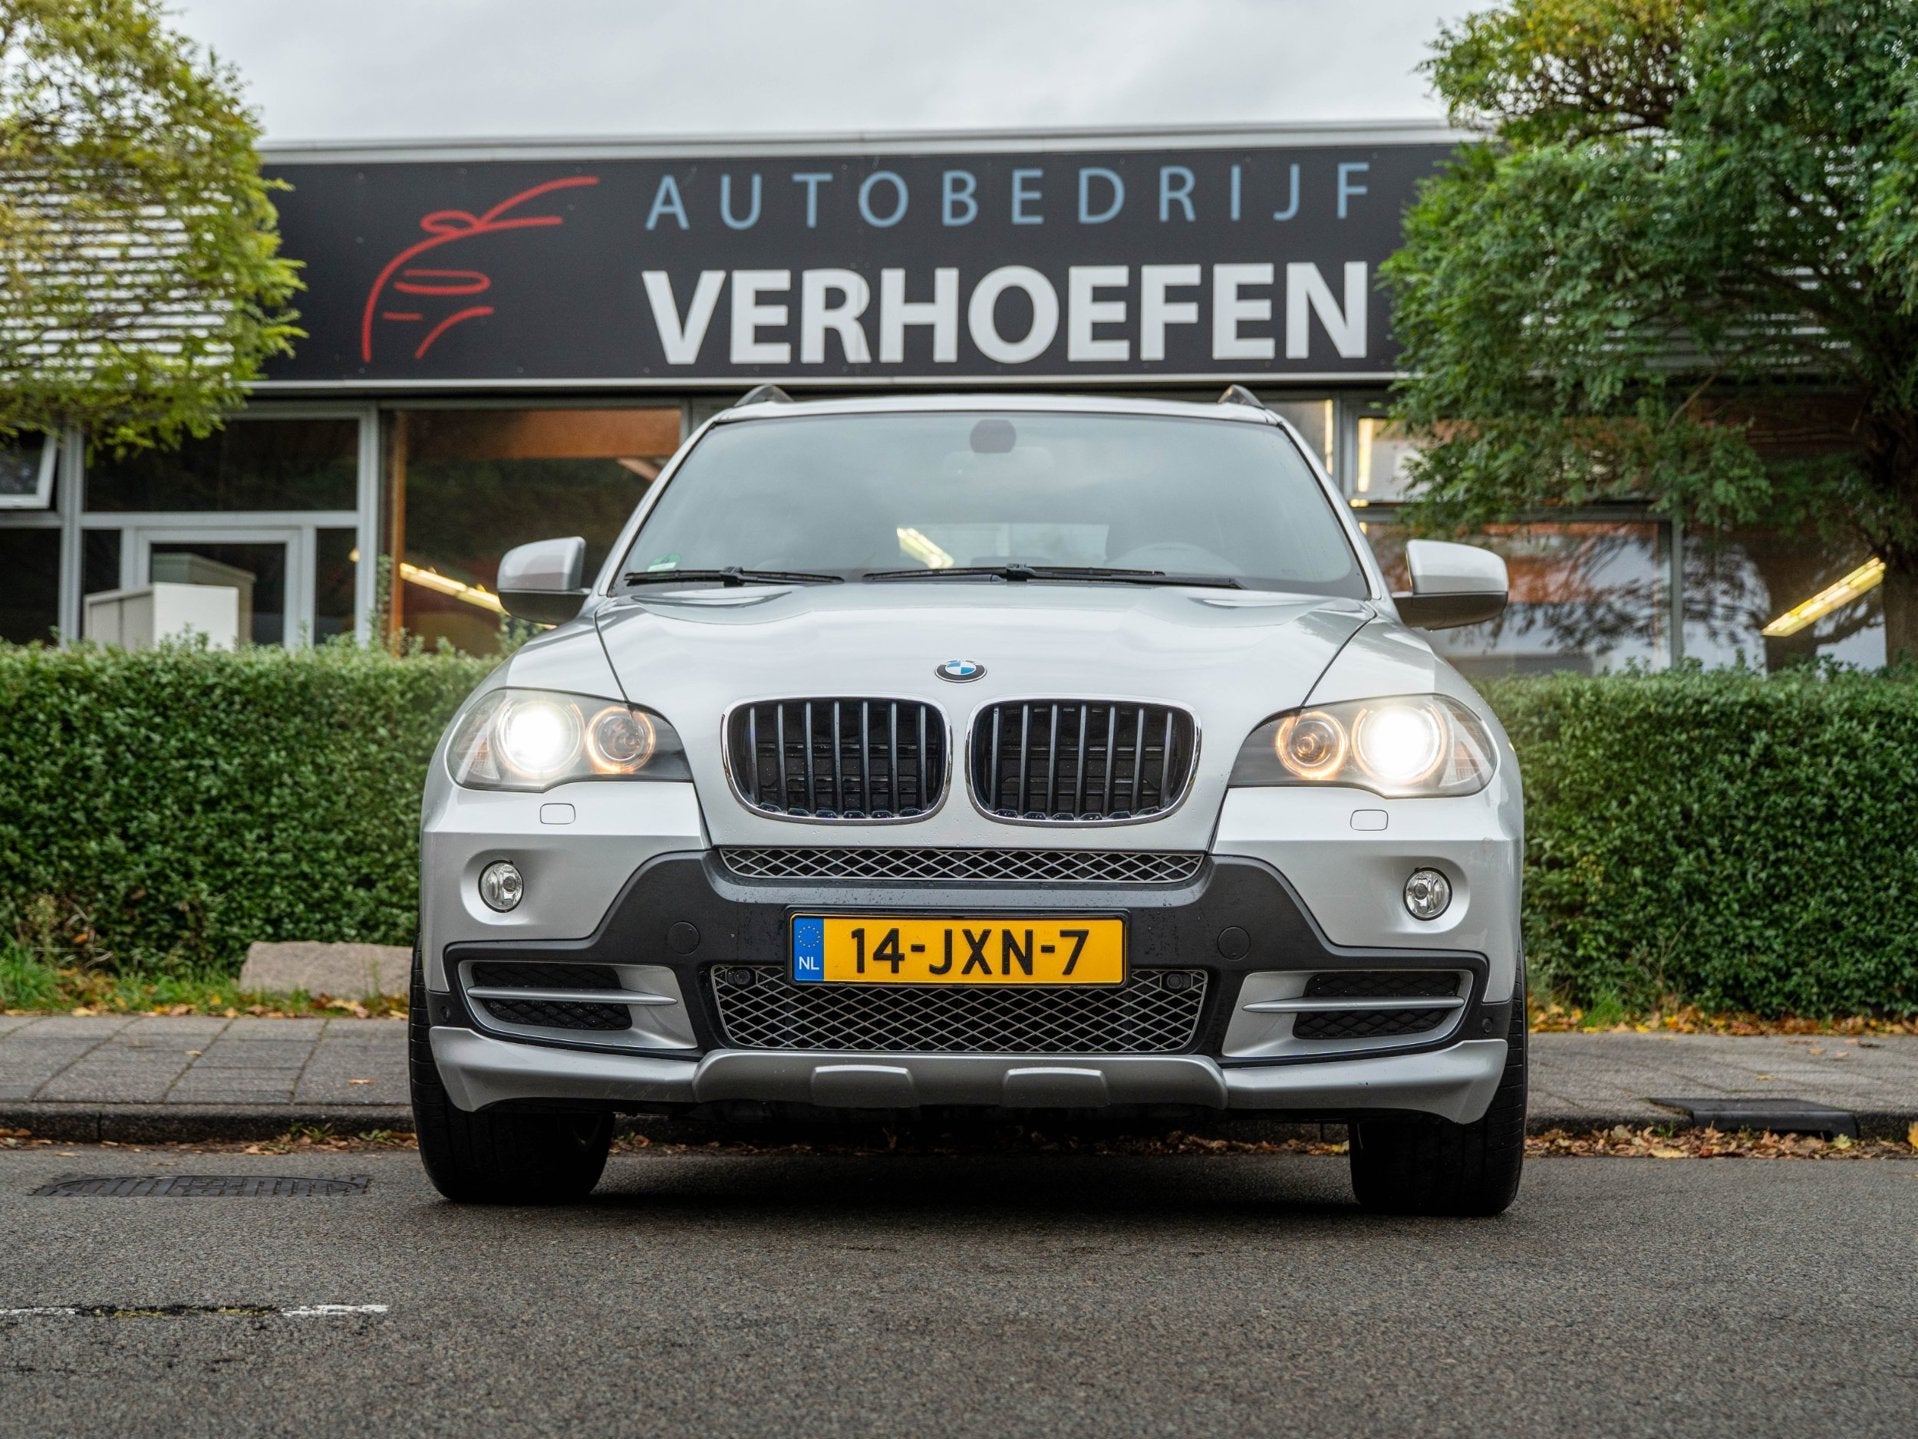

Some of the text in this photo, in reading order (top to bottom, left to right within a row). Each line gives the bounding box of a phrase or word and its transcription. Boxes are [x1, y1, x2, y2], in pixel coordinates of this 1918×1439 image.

[645, 162, 1369, 231] AUTOBEDRIJF
[641, 261, 1368, 365] VERHOEFEN
[798, 956, 820, 971] NL
[850, 927, 1090, 976] 14-JXN-7
